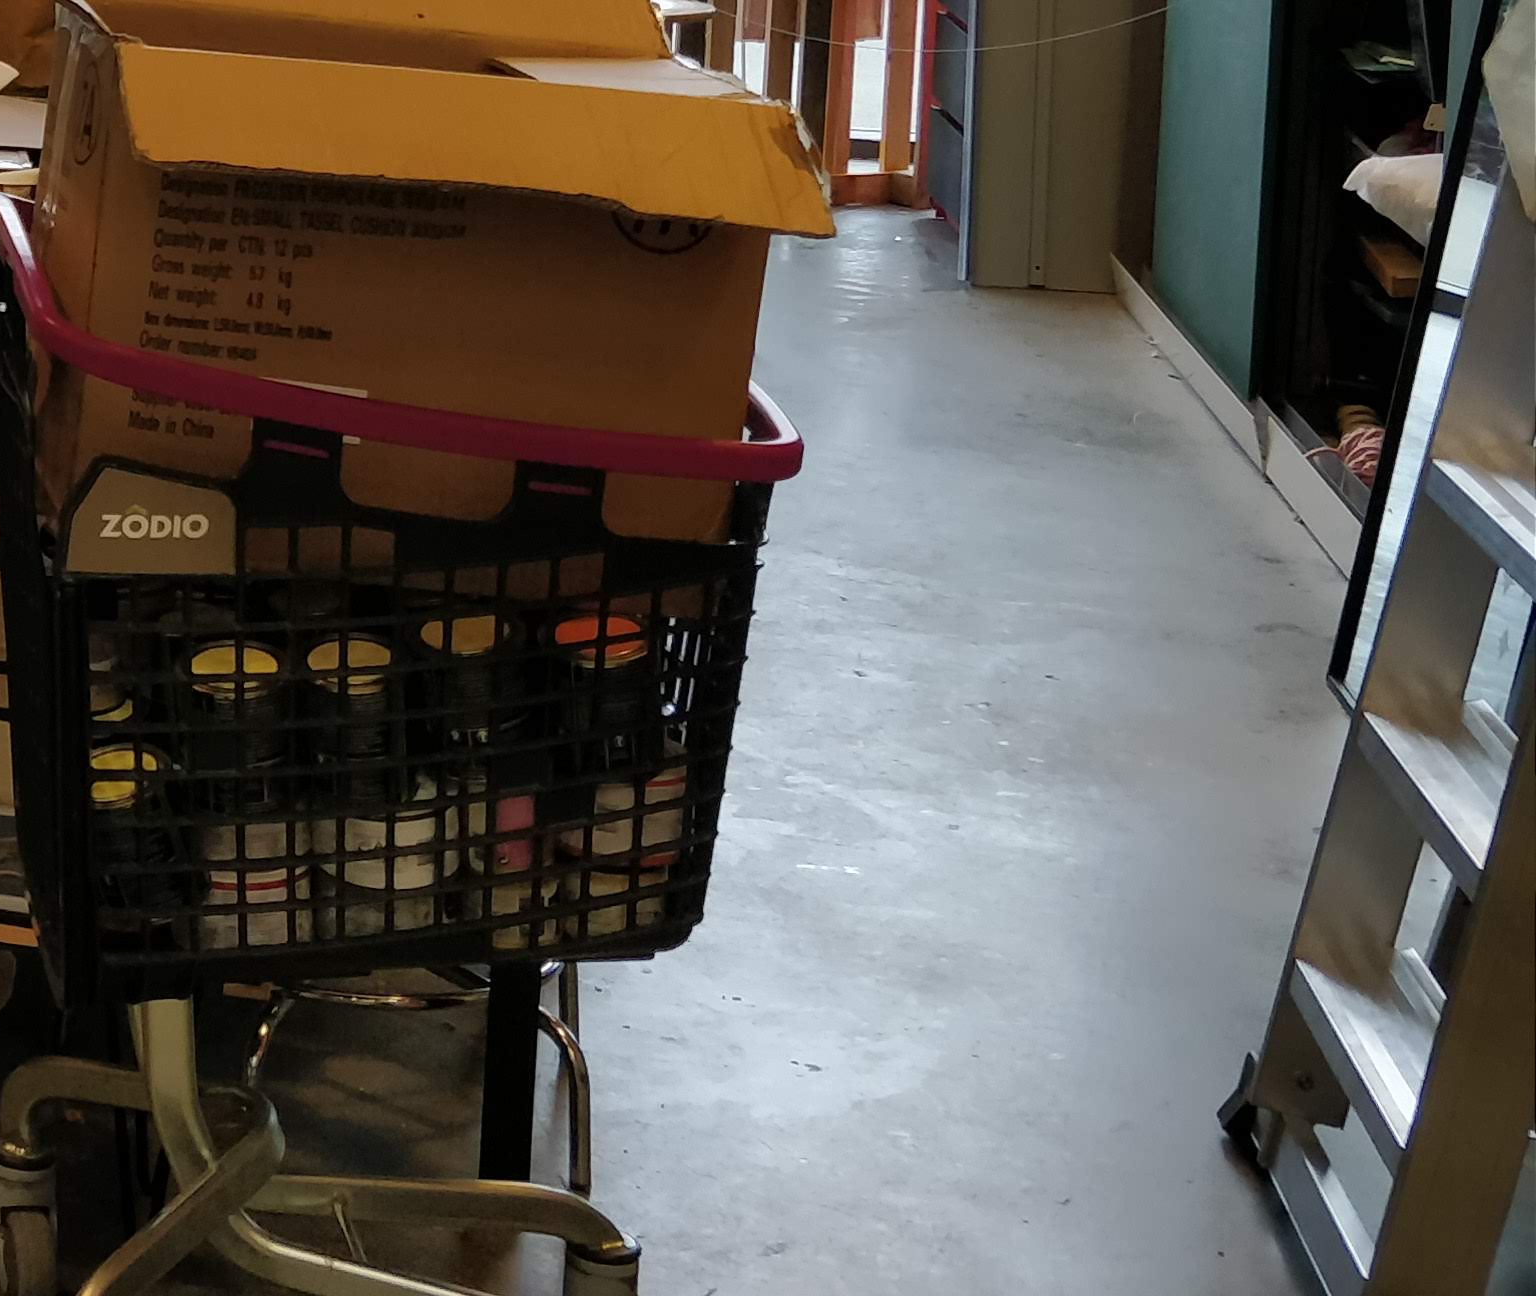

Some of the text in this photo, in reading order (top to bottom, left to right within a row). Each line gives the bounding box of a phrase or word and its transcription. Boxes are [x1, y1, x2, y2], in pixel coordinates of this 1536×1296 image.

[154, 228, 205, 253] Quantity
[209, 237, 229, 253] per
[152, 254, 184, 275] Gross
[278, 270, 293, 289] kg
[148, 280, 170, 301] Net
[277, 294, 292, 316] kg
[139, 330, 173, 352] Order
[128, 410, 215, 439] Made in China
